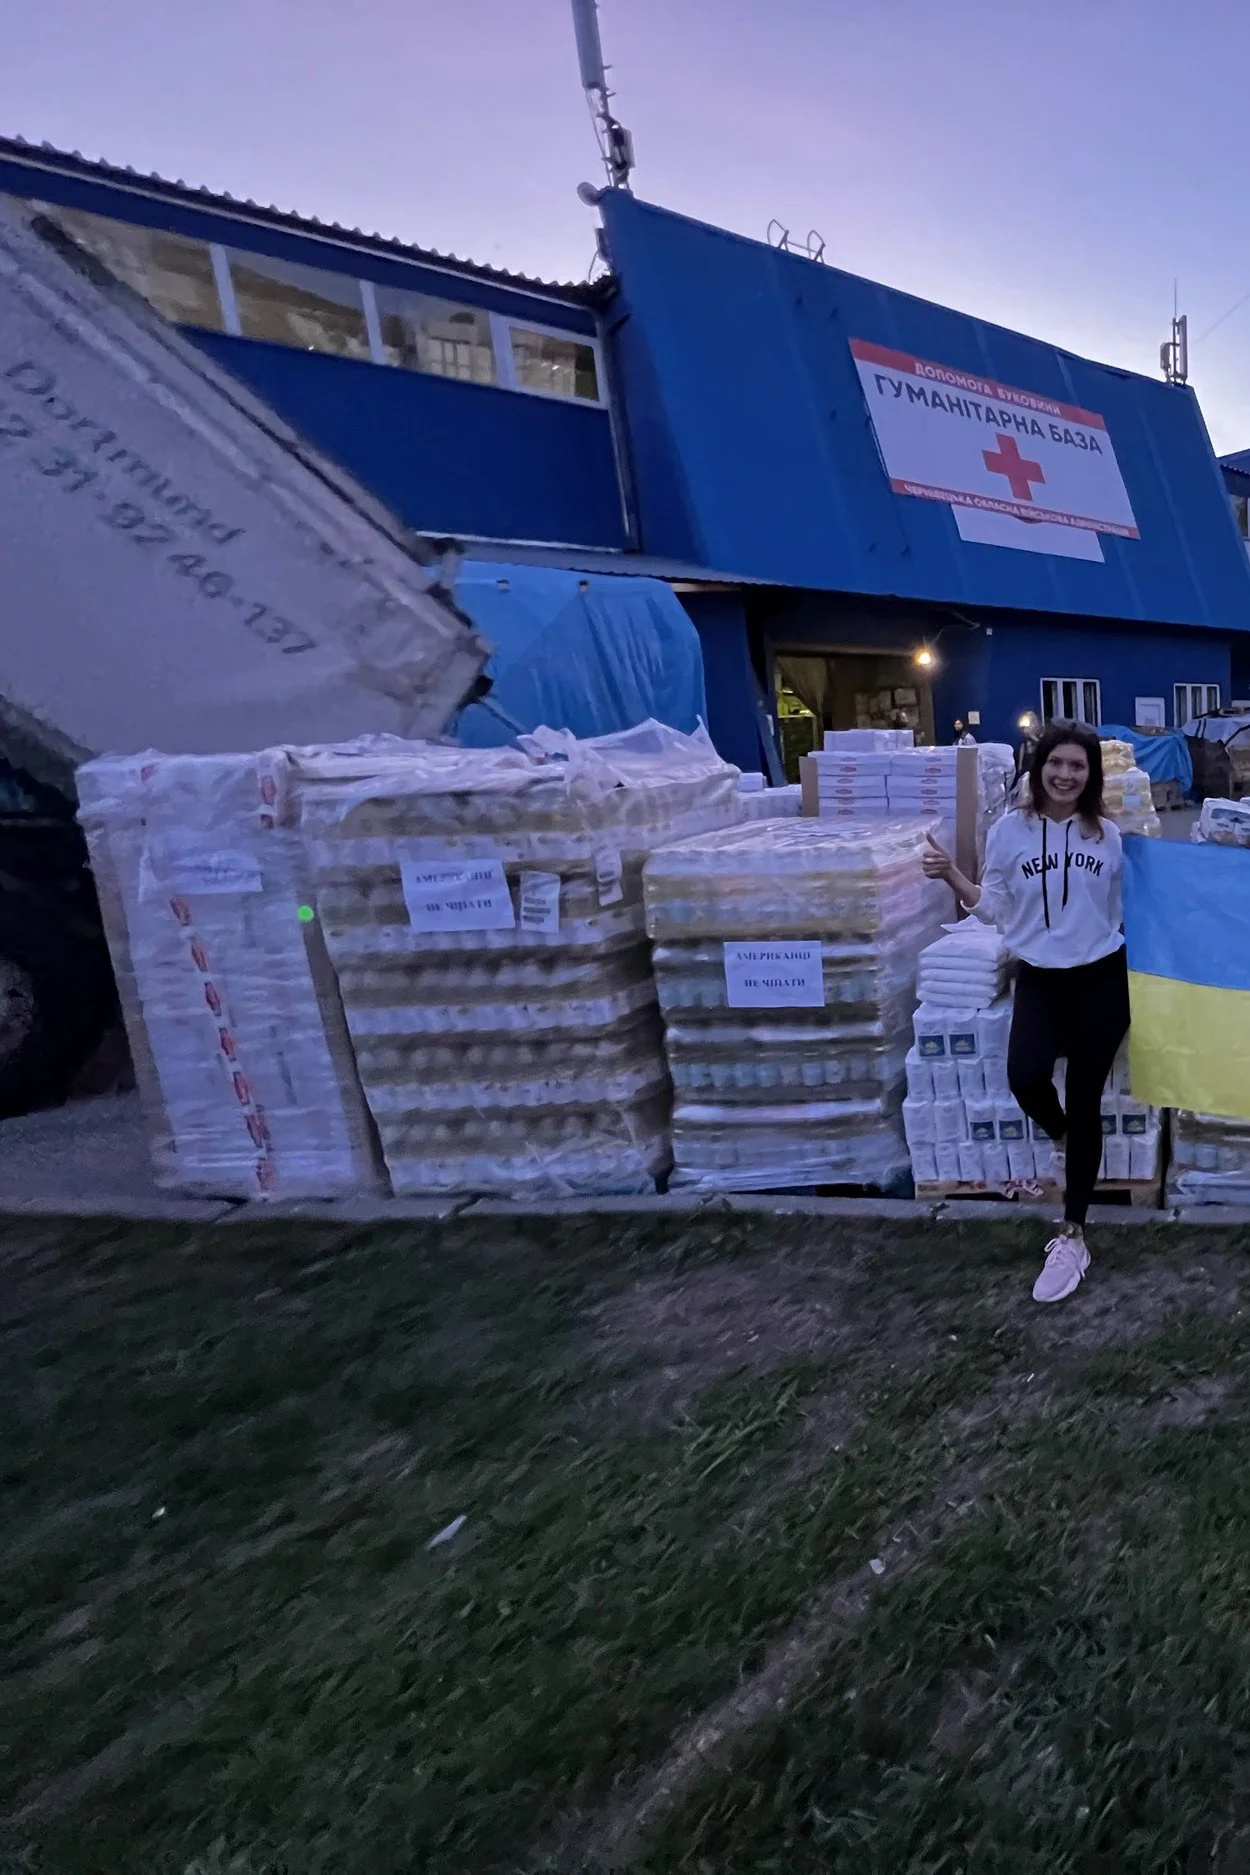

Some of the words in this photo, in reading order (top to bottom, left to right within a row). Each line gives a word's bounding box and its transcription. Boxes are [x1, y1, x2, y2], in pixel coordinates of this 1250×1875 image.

[874, 373, 1046, 439] ГУМАНІТАРНА
[1048, 422, 1103, 455] БАЗА
[914, 362, 993, 396] ДОПОМОГА
[997, 387, 1062, 416] БУКОВИНИ
[4, 360, 246, 544] Dortmund
[1021, 852, 1058, 880] NEW
[1065, 852, 1104, 877] YORK
